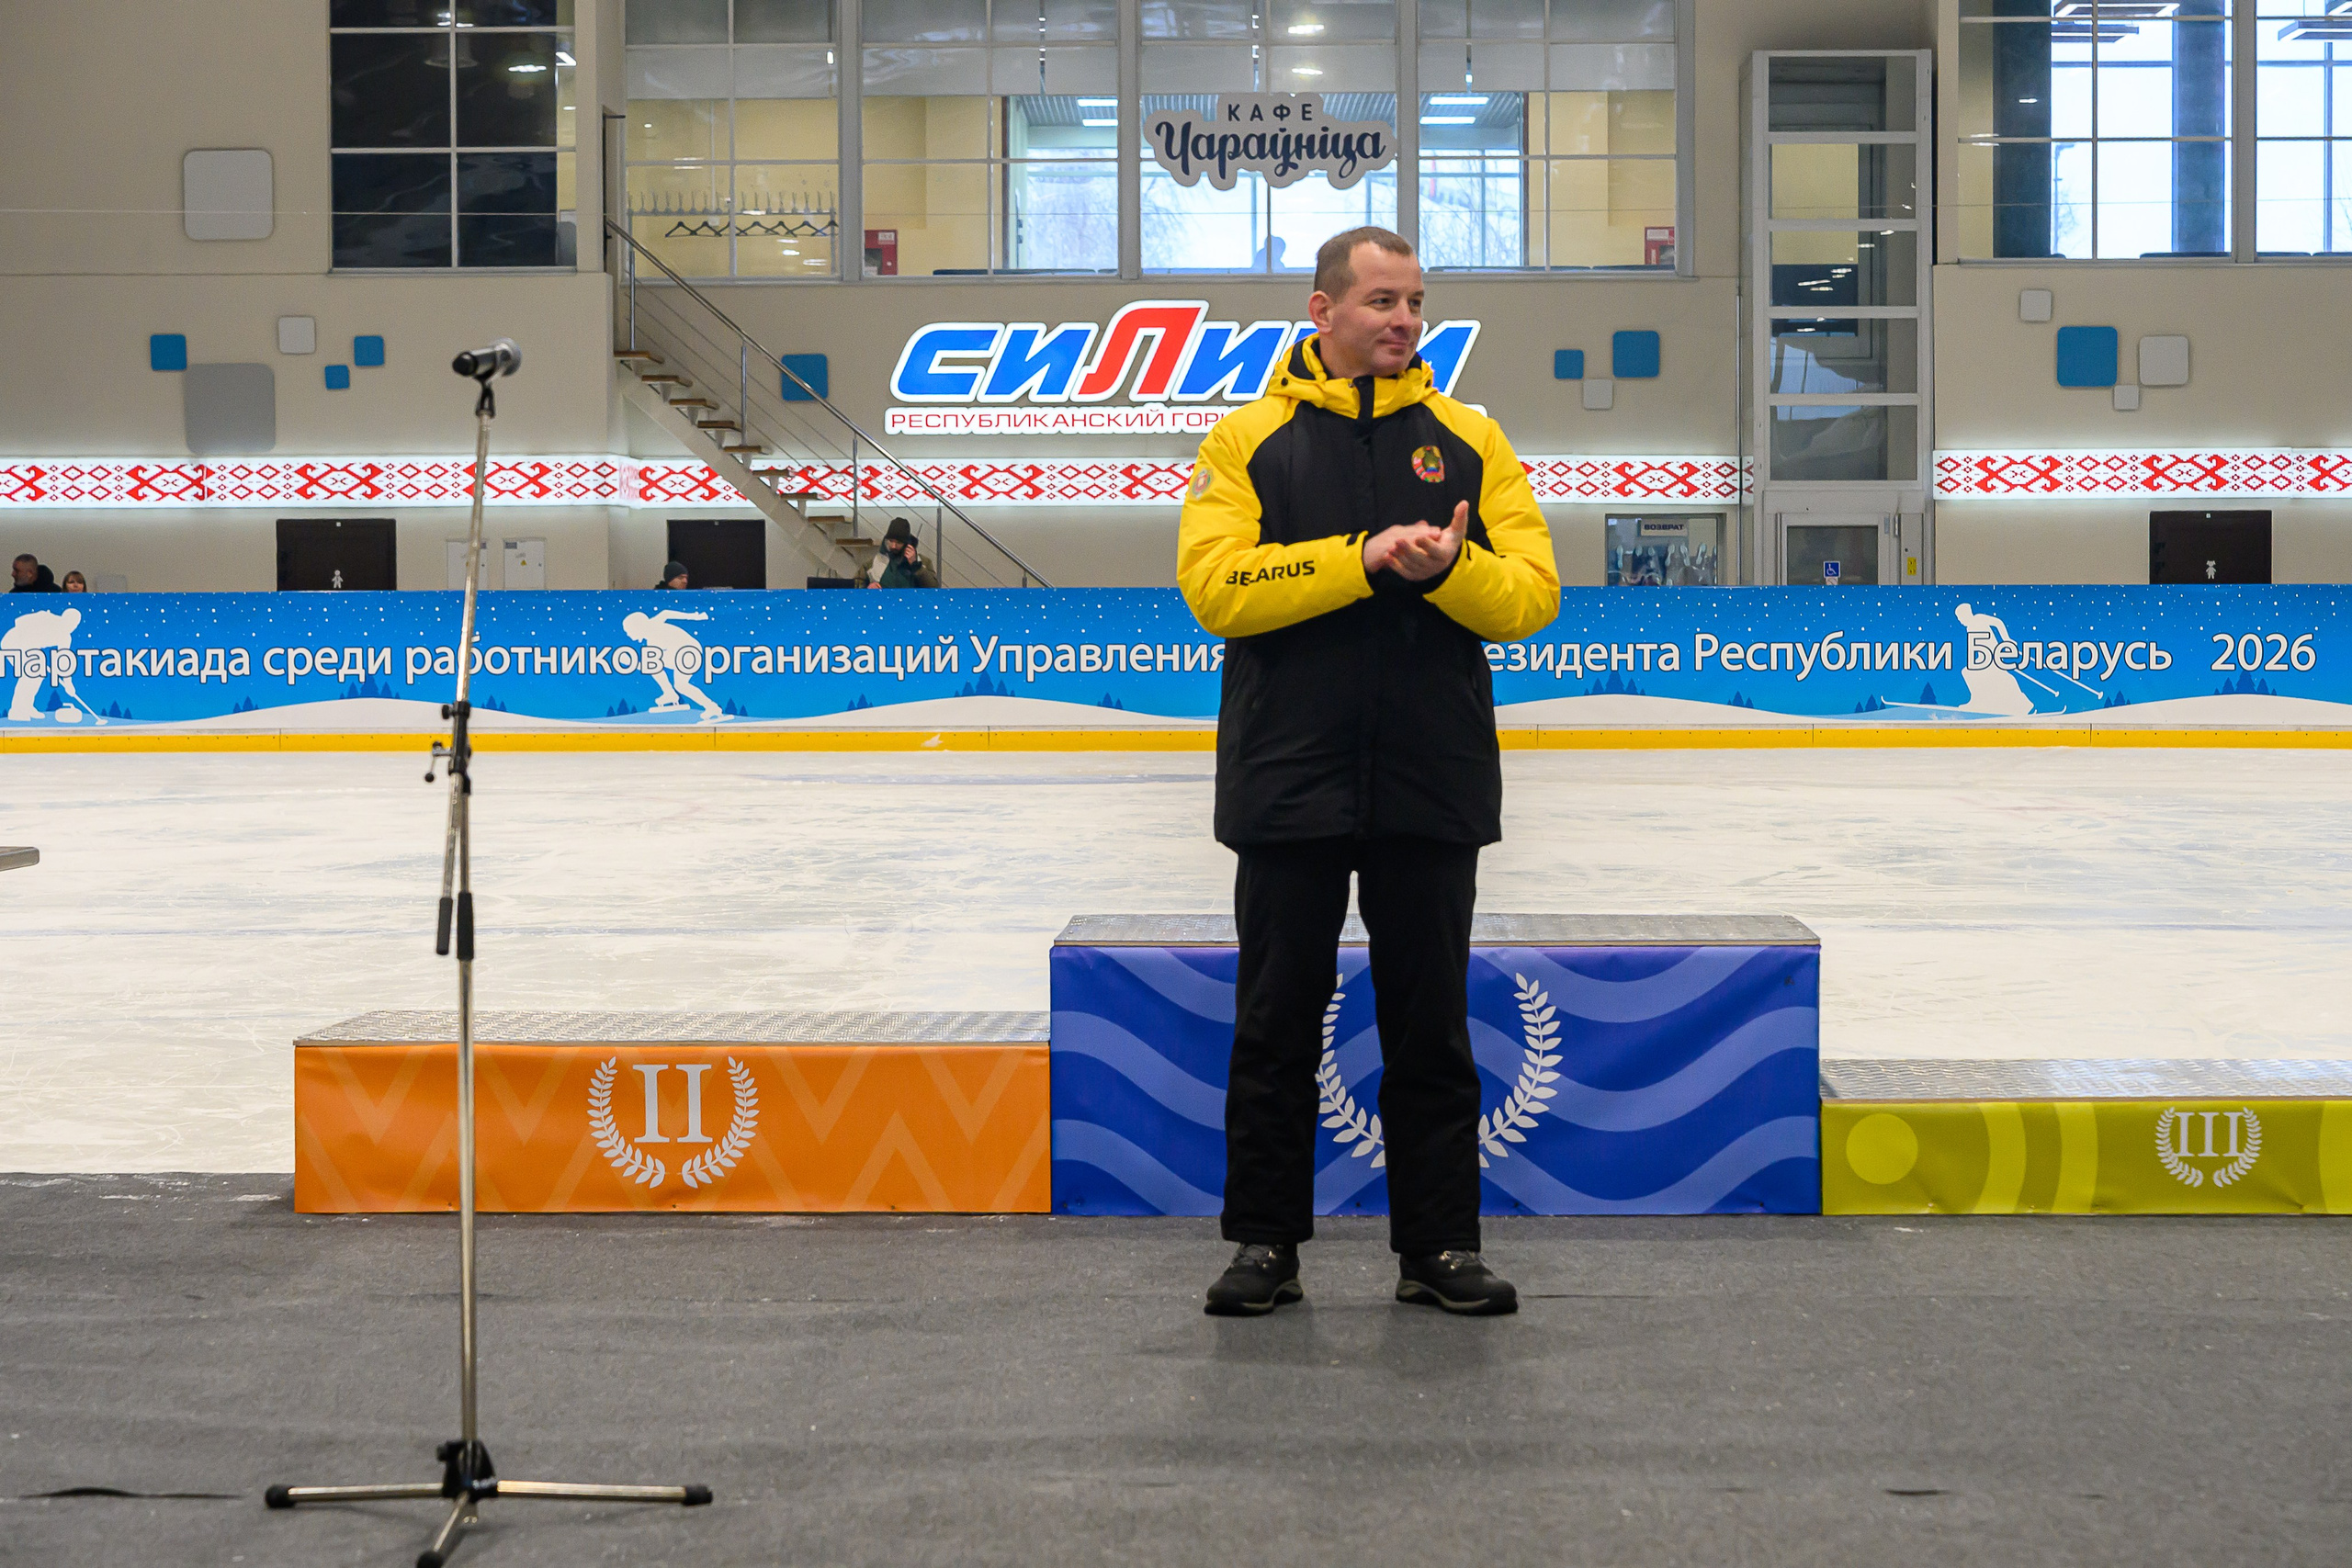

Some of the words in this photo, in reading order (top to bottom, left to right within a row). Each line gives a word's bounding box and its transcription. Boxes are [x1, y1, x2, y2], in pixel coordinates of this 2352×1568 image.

[1228, 104, 1313, 121] КАФЕ
[1155, 121, 1386, 179] Чараўніца
[890, 410, 1165, 428] РЕСПУБЛИКАНСКИЙ
[263, 646, 392, 684] среди
[405, 636, 665, 684] работников
[674, 636, 960, 682] организаций
[969, 635, 1225, 682] Управления
[1694, 631, 1953, 682] Республики
[1966, 631, 2173, 681] Беларусь
[2211, 633, 2317, 671] 2026
[632, 1064, 713, 1143] II
[2175, 1111, 2245, 1157] III
